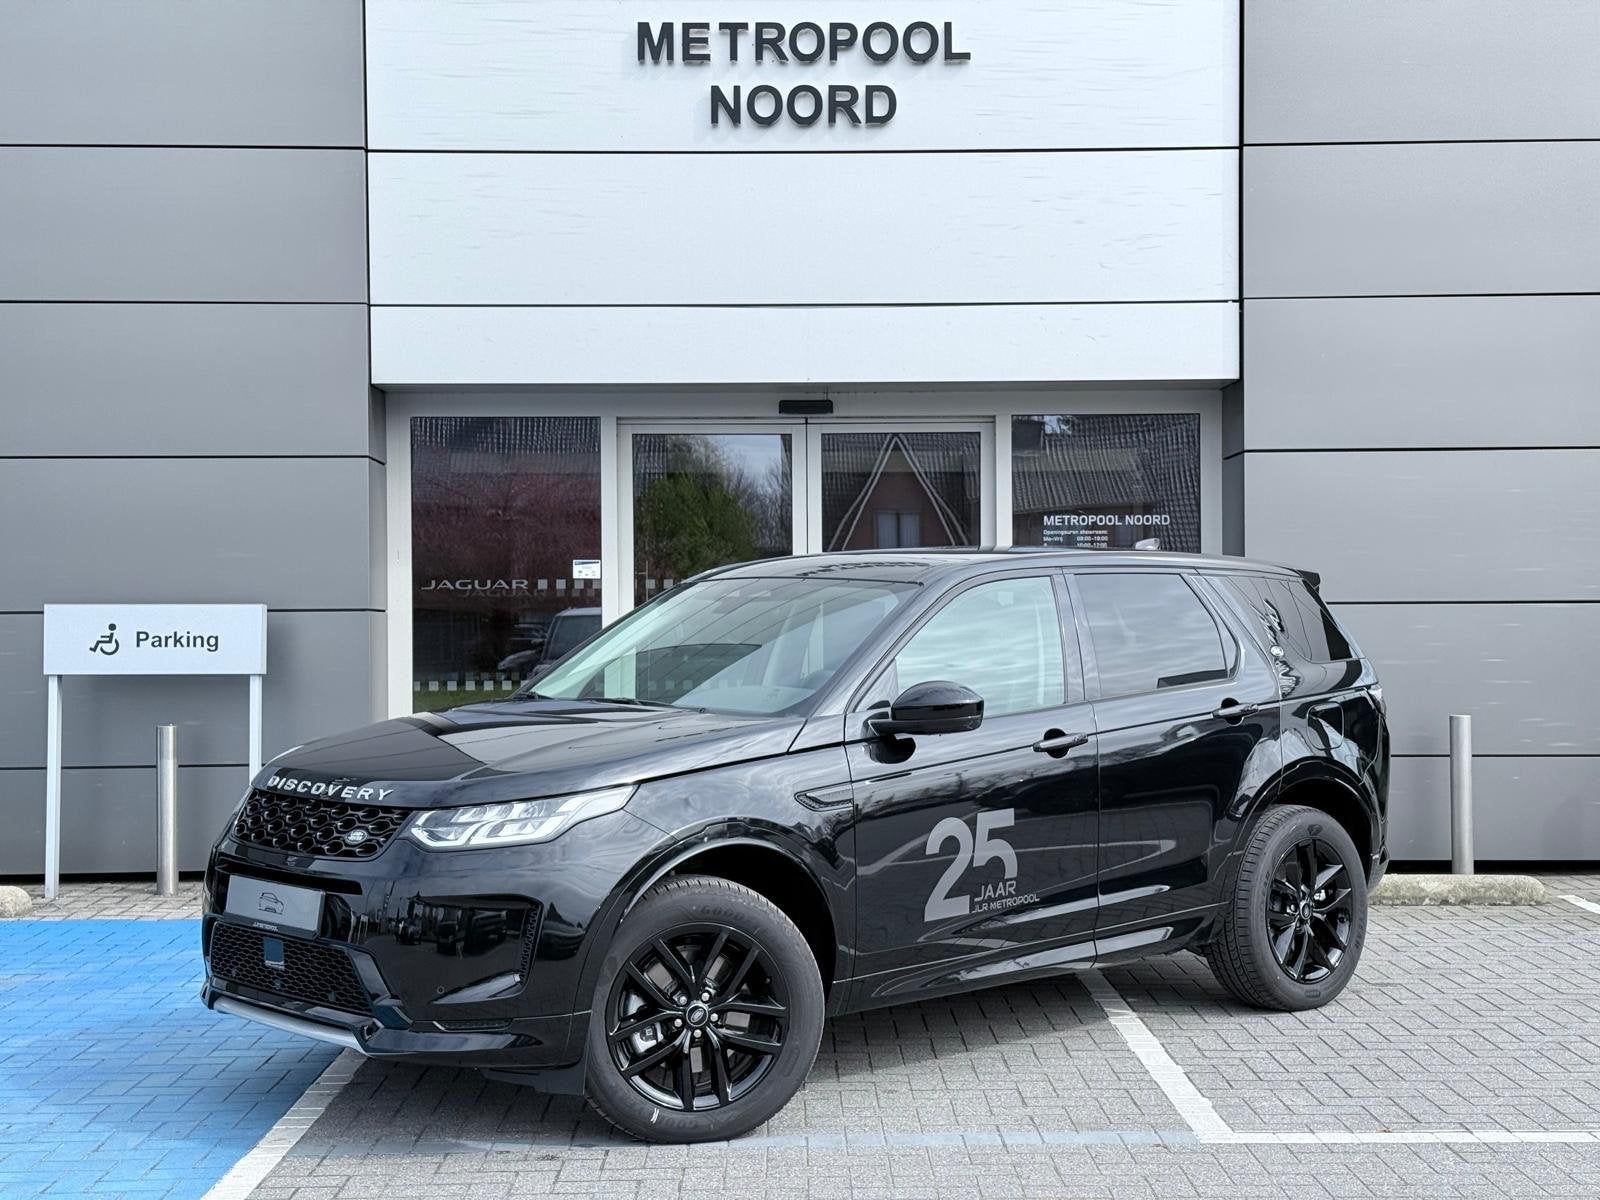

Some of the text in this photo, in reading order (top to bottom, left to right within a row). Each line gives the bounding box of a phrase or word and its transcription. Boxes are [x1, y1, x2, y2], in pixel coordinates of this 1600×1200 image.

[637, 21, 971, 64] METROPOOL
[710, 84, 897, 127] NOORD
[1043, 514, 1170, 526] METROPOOL NOORD
[421, 579, 529, 590] JAGUAR
[136, 630, 219, 652] Parking
[267, 775, 394, 801] DISCOVERY
[924, 808, 1018, 922] 25
[974, 880, 1016, 902] JAAR
[990, 893, 1040, 910] METROPOOL
